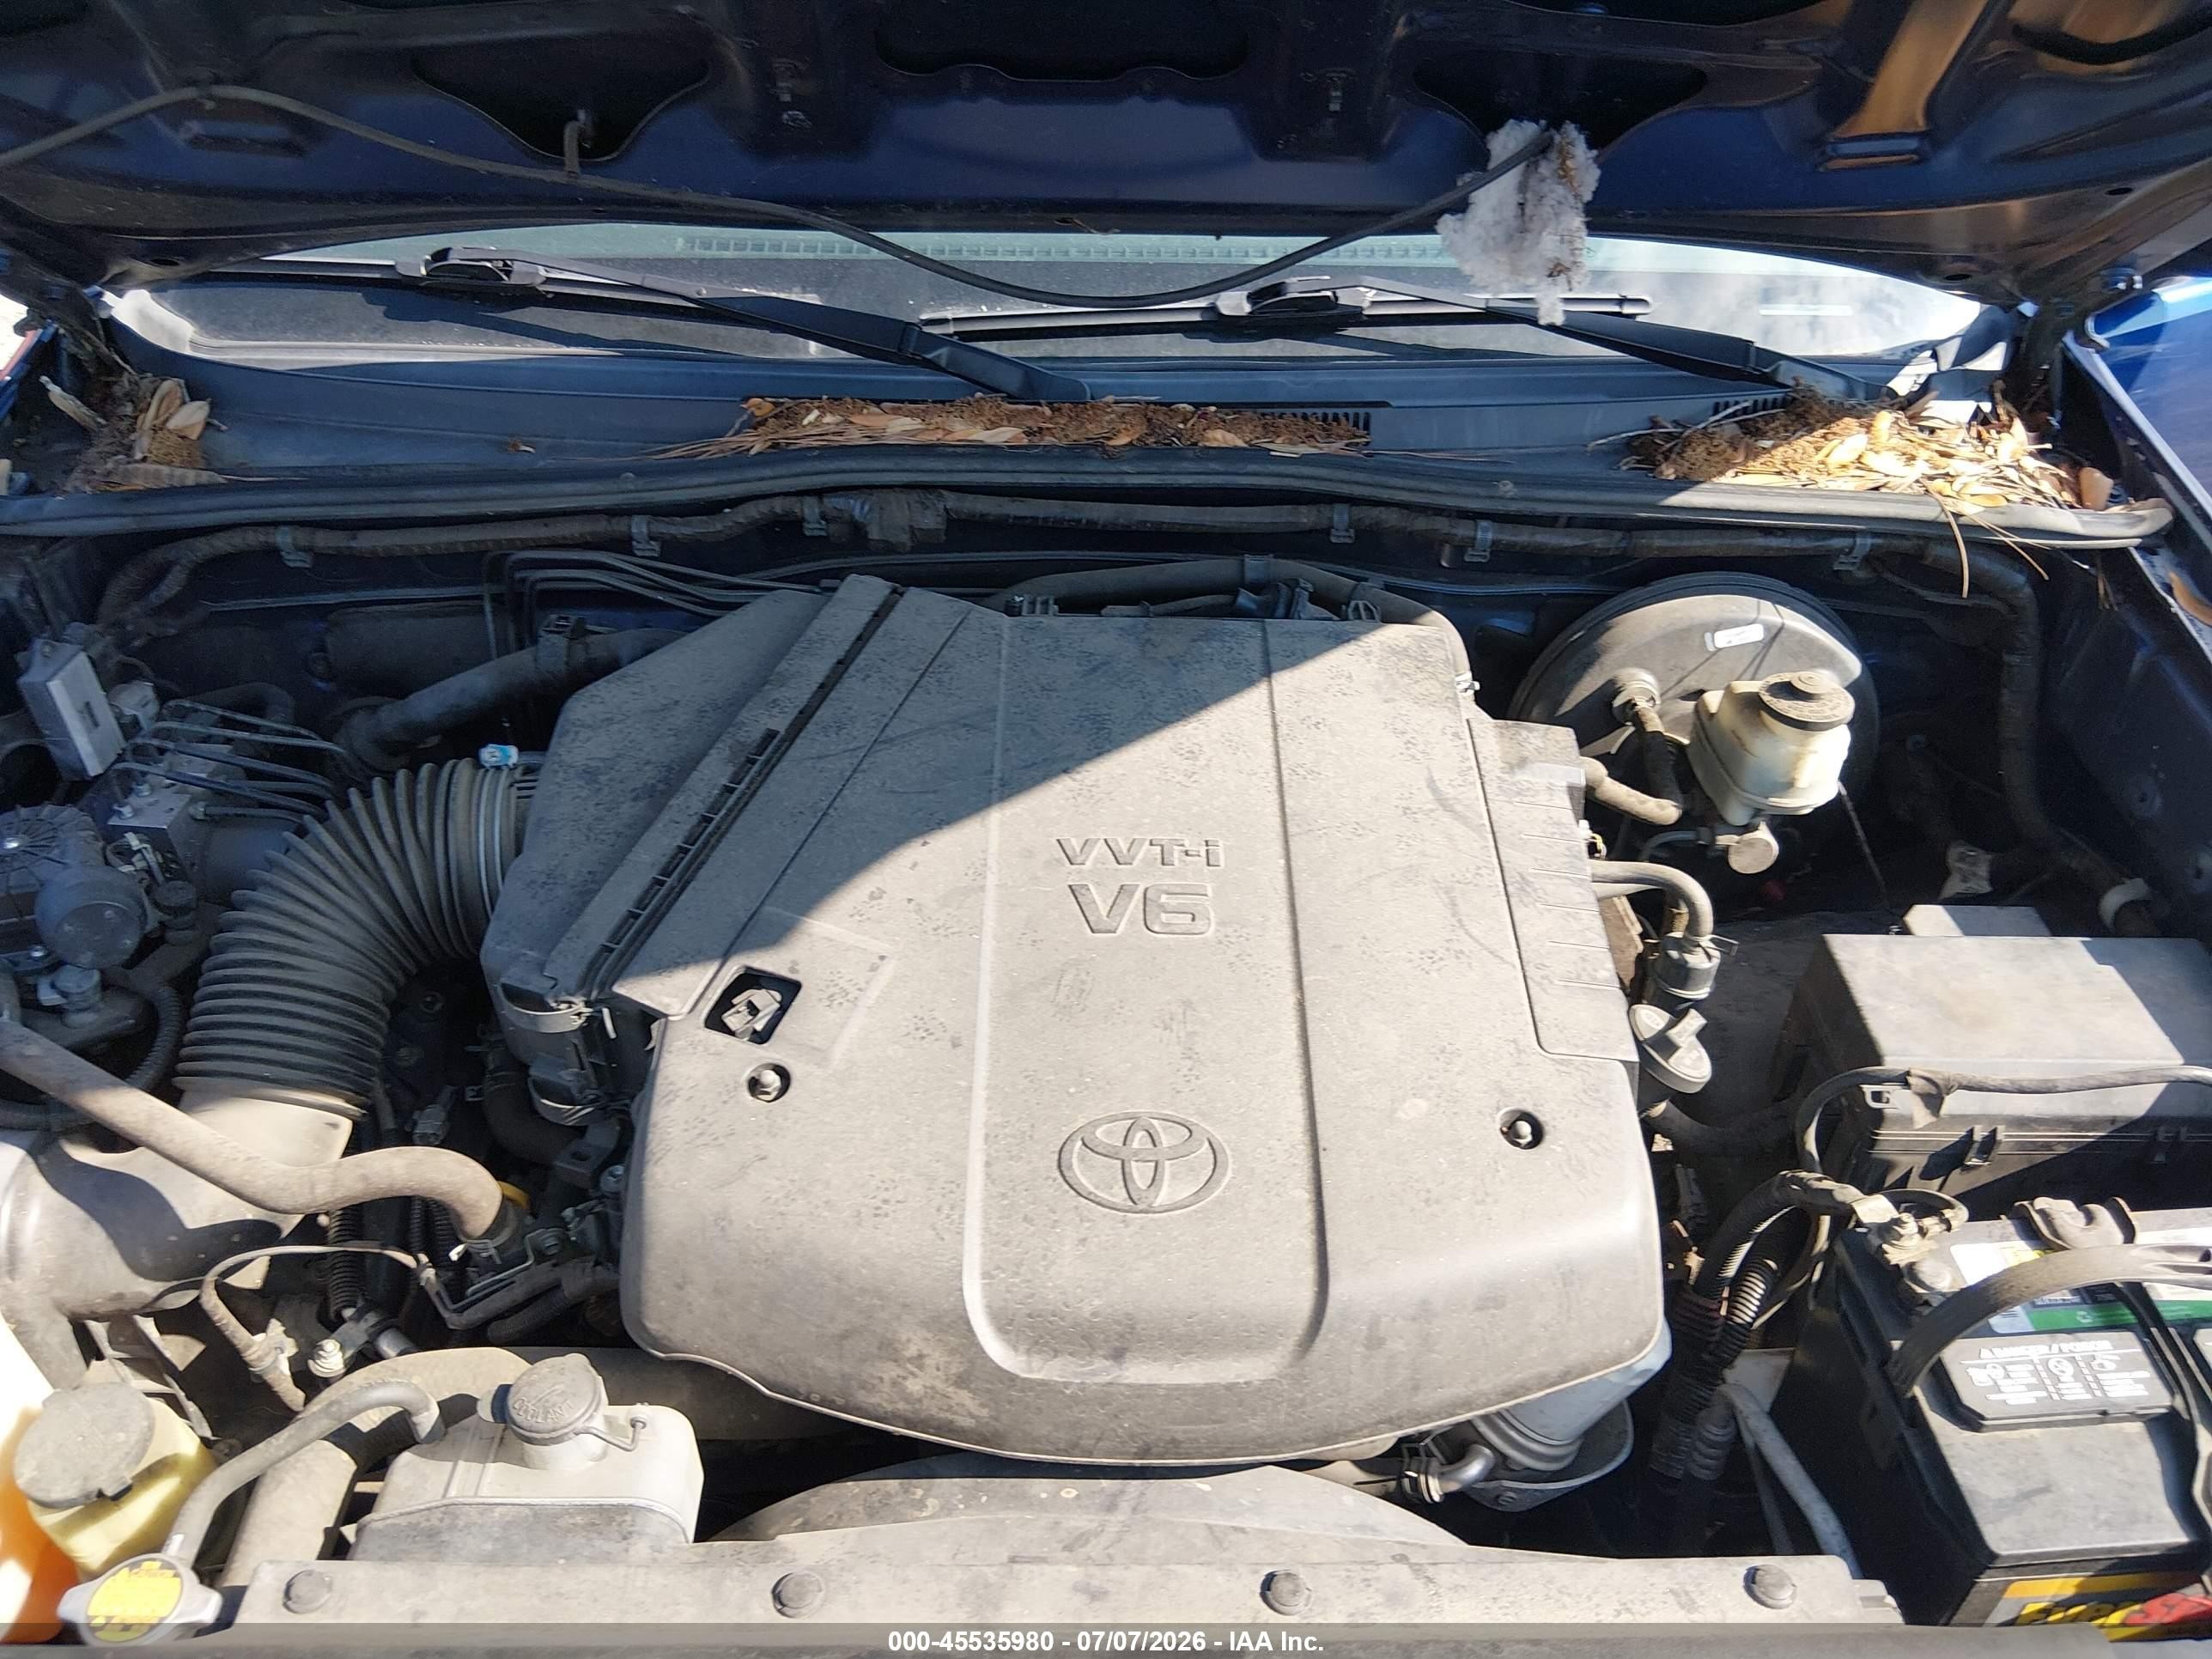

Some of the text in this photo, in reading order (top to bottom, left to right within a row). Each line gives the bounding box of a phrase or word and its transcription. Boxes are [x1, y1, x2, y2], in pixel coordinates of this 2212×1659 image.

[1056, 838, 1224, 867] VVT-i
[1068, 883, 1215, 937] V6
[513, 1396, 573, 1424] COOLANT
